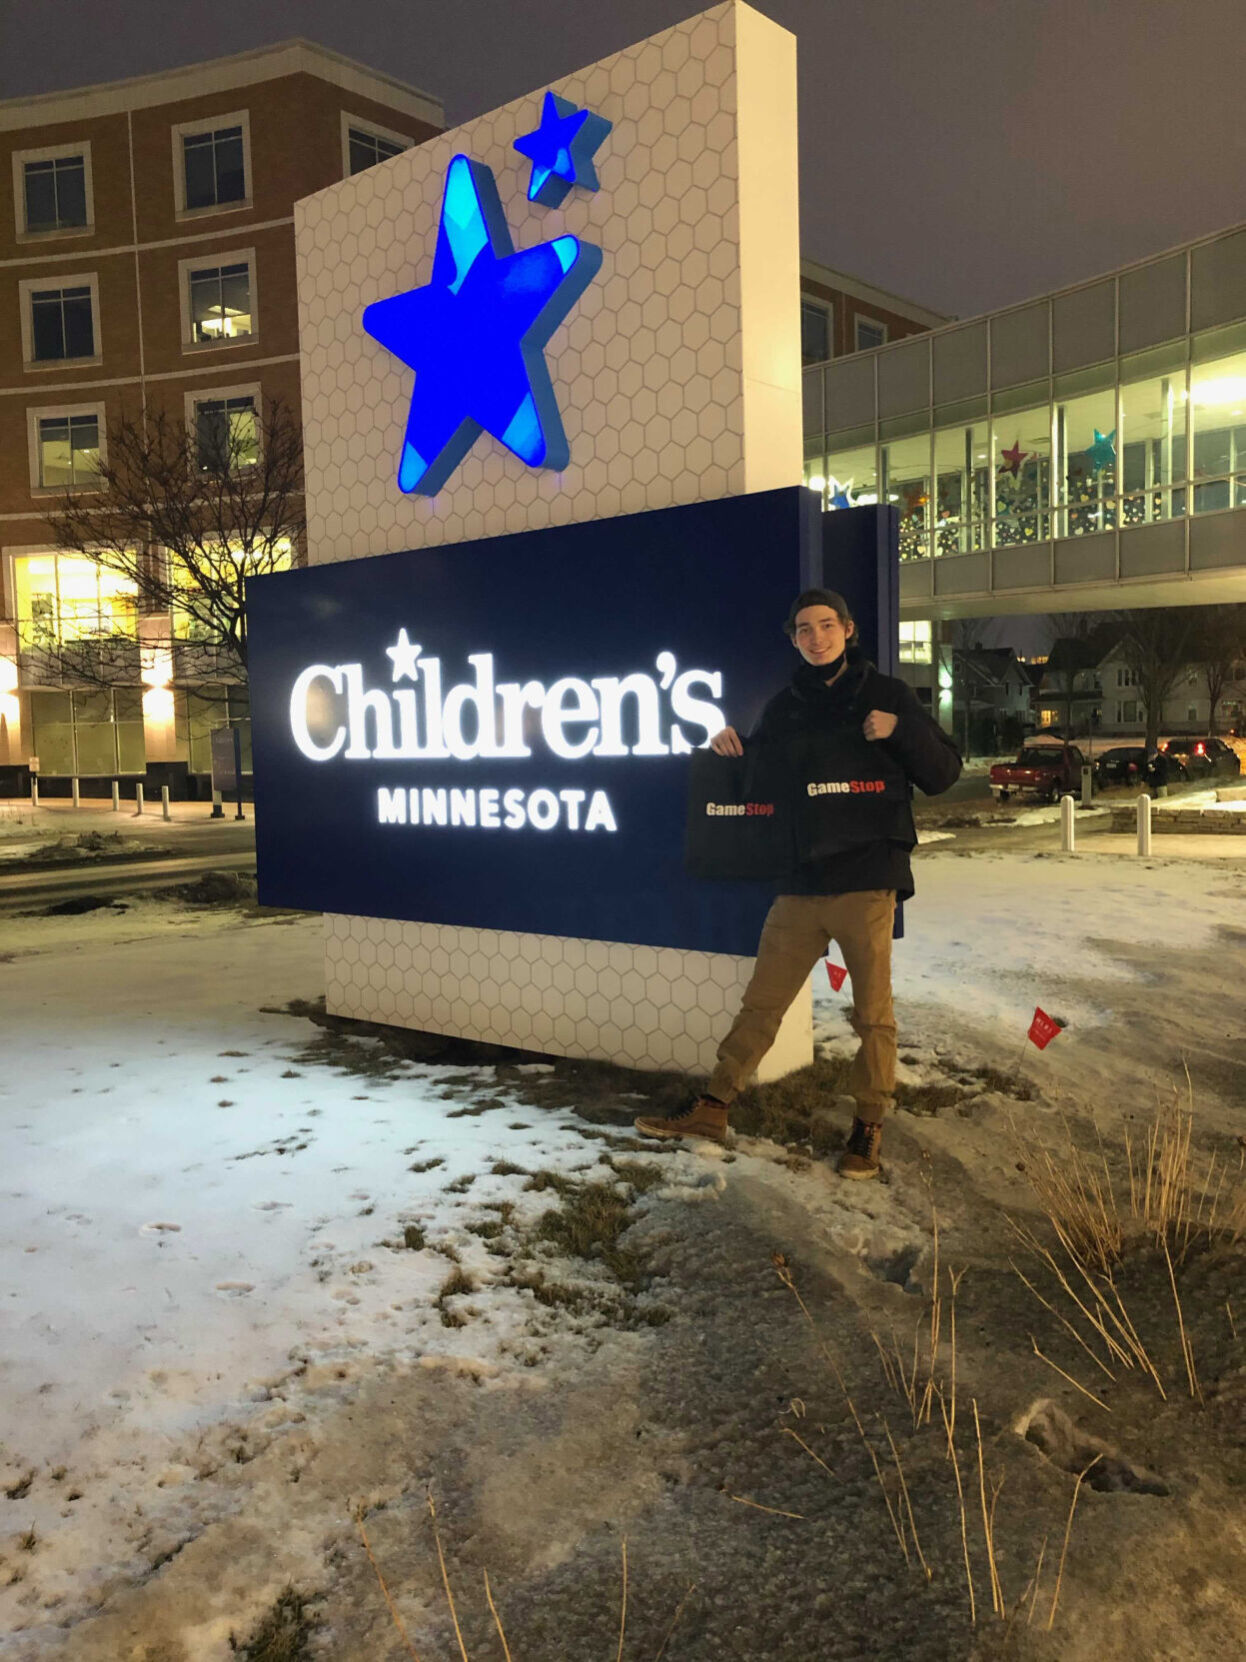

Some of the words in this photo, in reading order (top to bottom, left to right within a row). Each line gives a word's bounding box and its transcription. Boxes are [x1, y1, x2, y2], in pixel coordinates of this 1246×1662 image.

[290, 628, 726, 760] Children's
[807, 780, 885, 796] GameStop
[378, 788, 617, 831] MINNESOTA
[706, 802, 774, 816] GameStop
